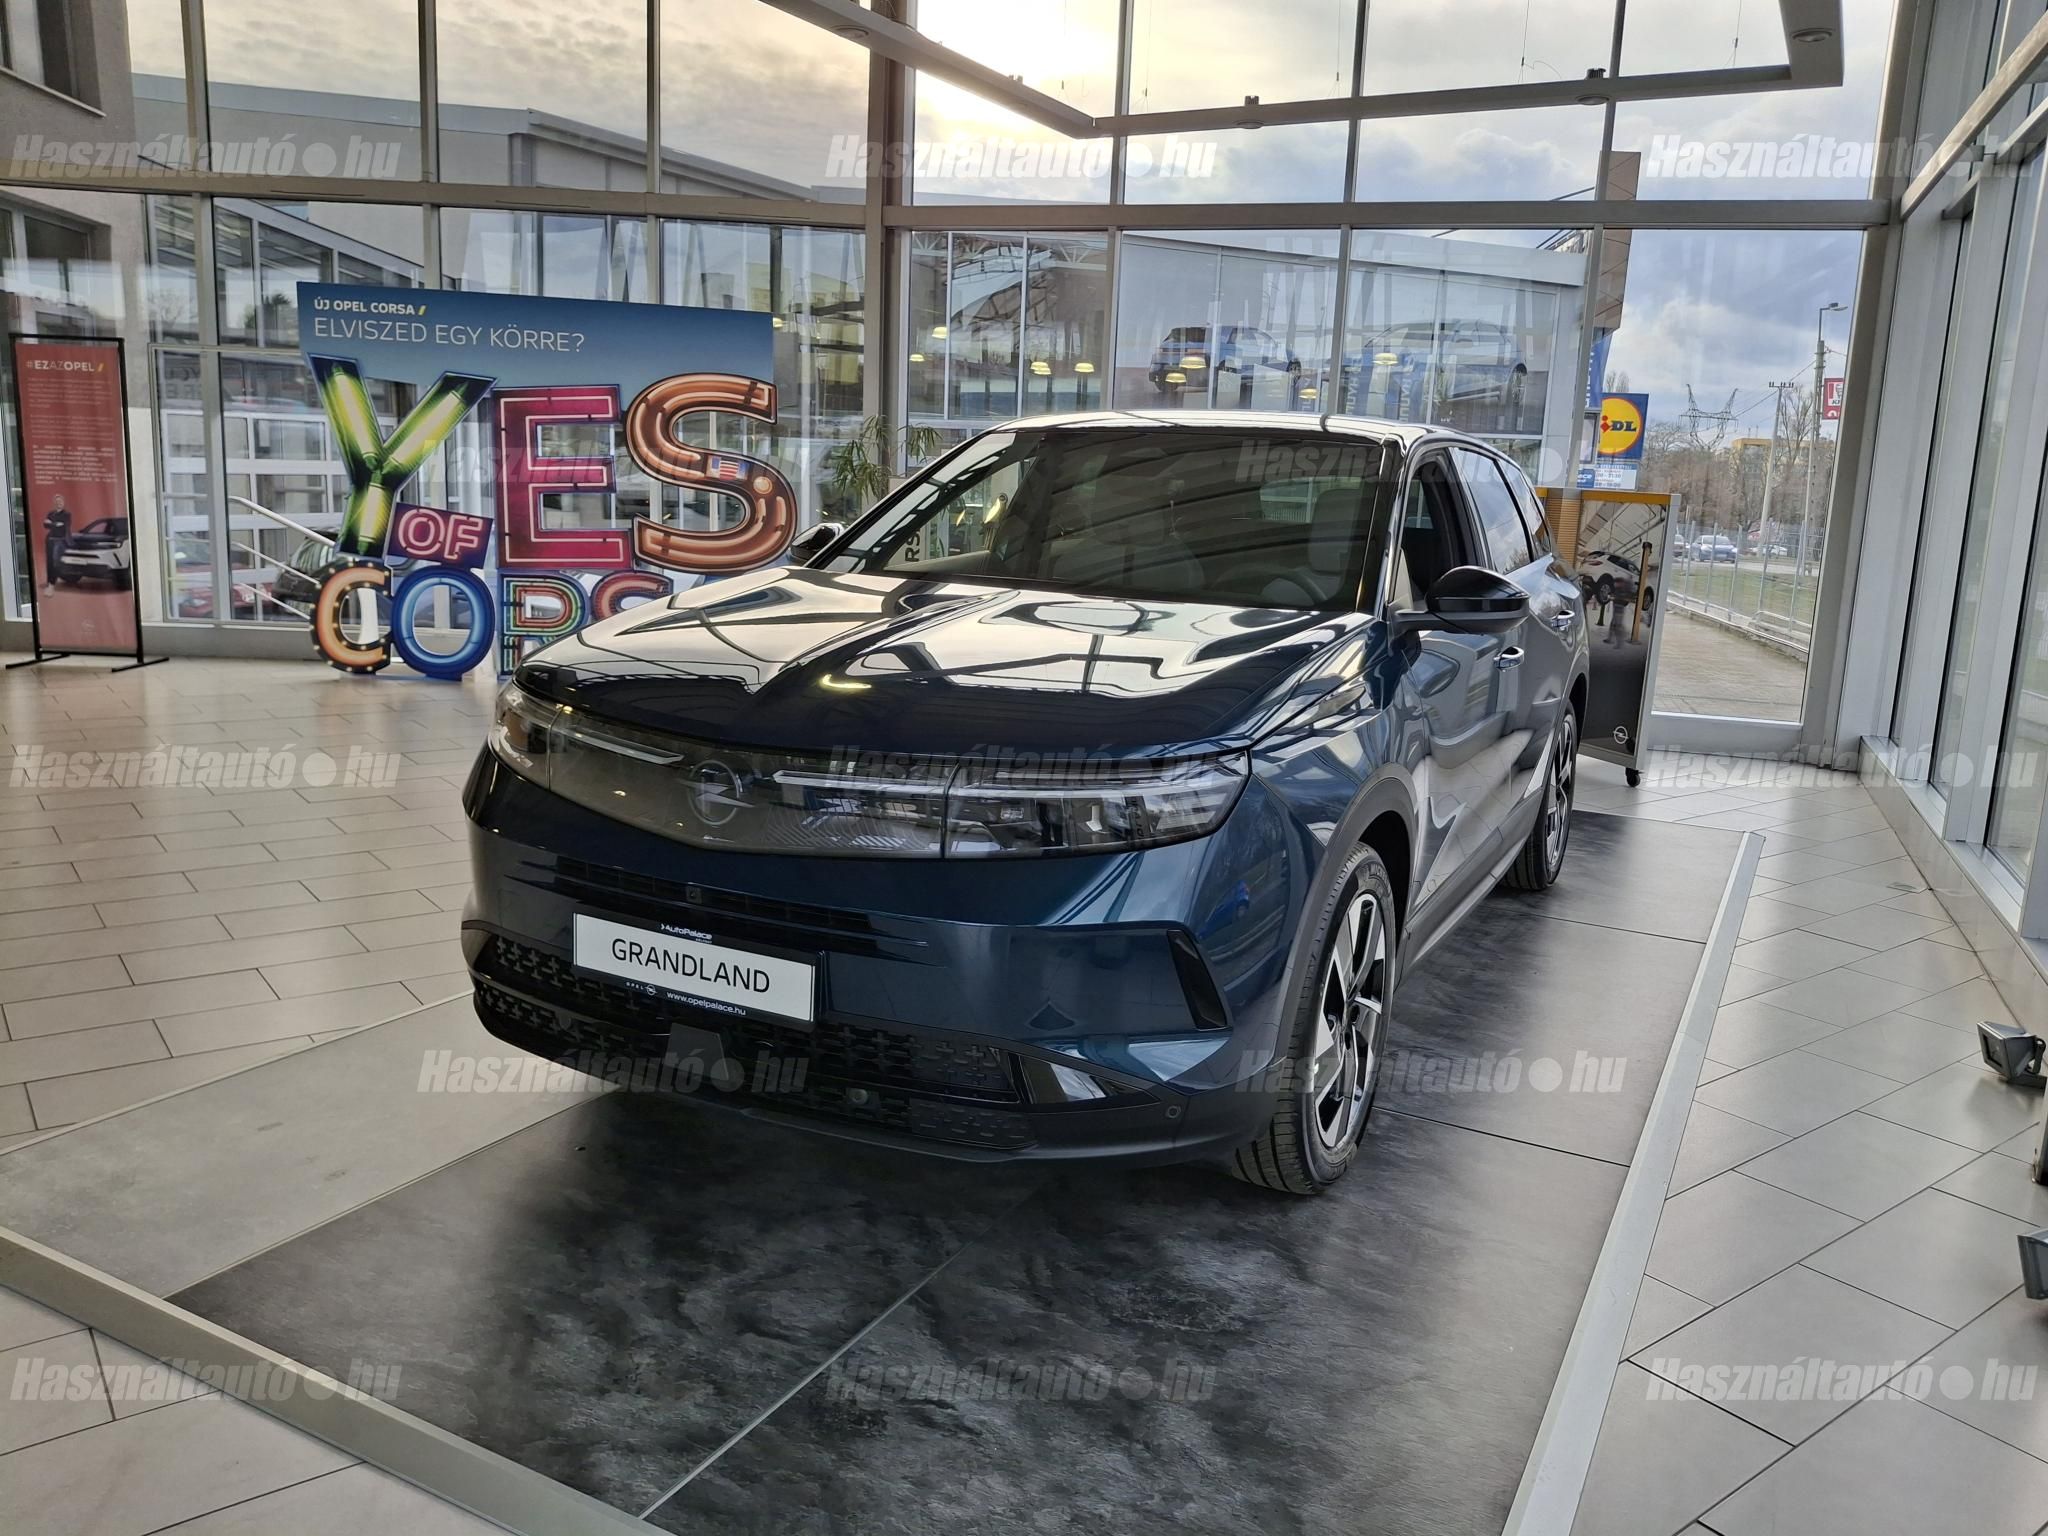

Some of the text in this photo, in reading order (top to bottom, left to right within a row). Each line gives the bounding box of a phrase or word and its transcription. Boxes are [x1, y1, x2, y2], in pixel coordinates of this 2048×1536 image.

[314, 296, 415, 315] ÚJ OPEL CORSA
[314, 317, 585, 353] ELVISZED EGY KÖRRE?
[25, 359, 95, 372] #EZAZOPEL
[1600, 414, 1638, 433] iDL
[307, 353, 799, 575] YES
[396, 507, 484, 562] OF
[665, 925, 712, 940] AutoPalace
[611, 938, 770, 993] GRANDLAND
[666, 991, 747, 1016] www.opelpalace.hu
